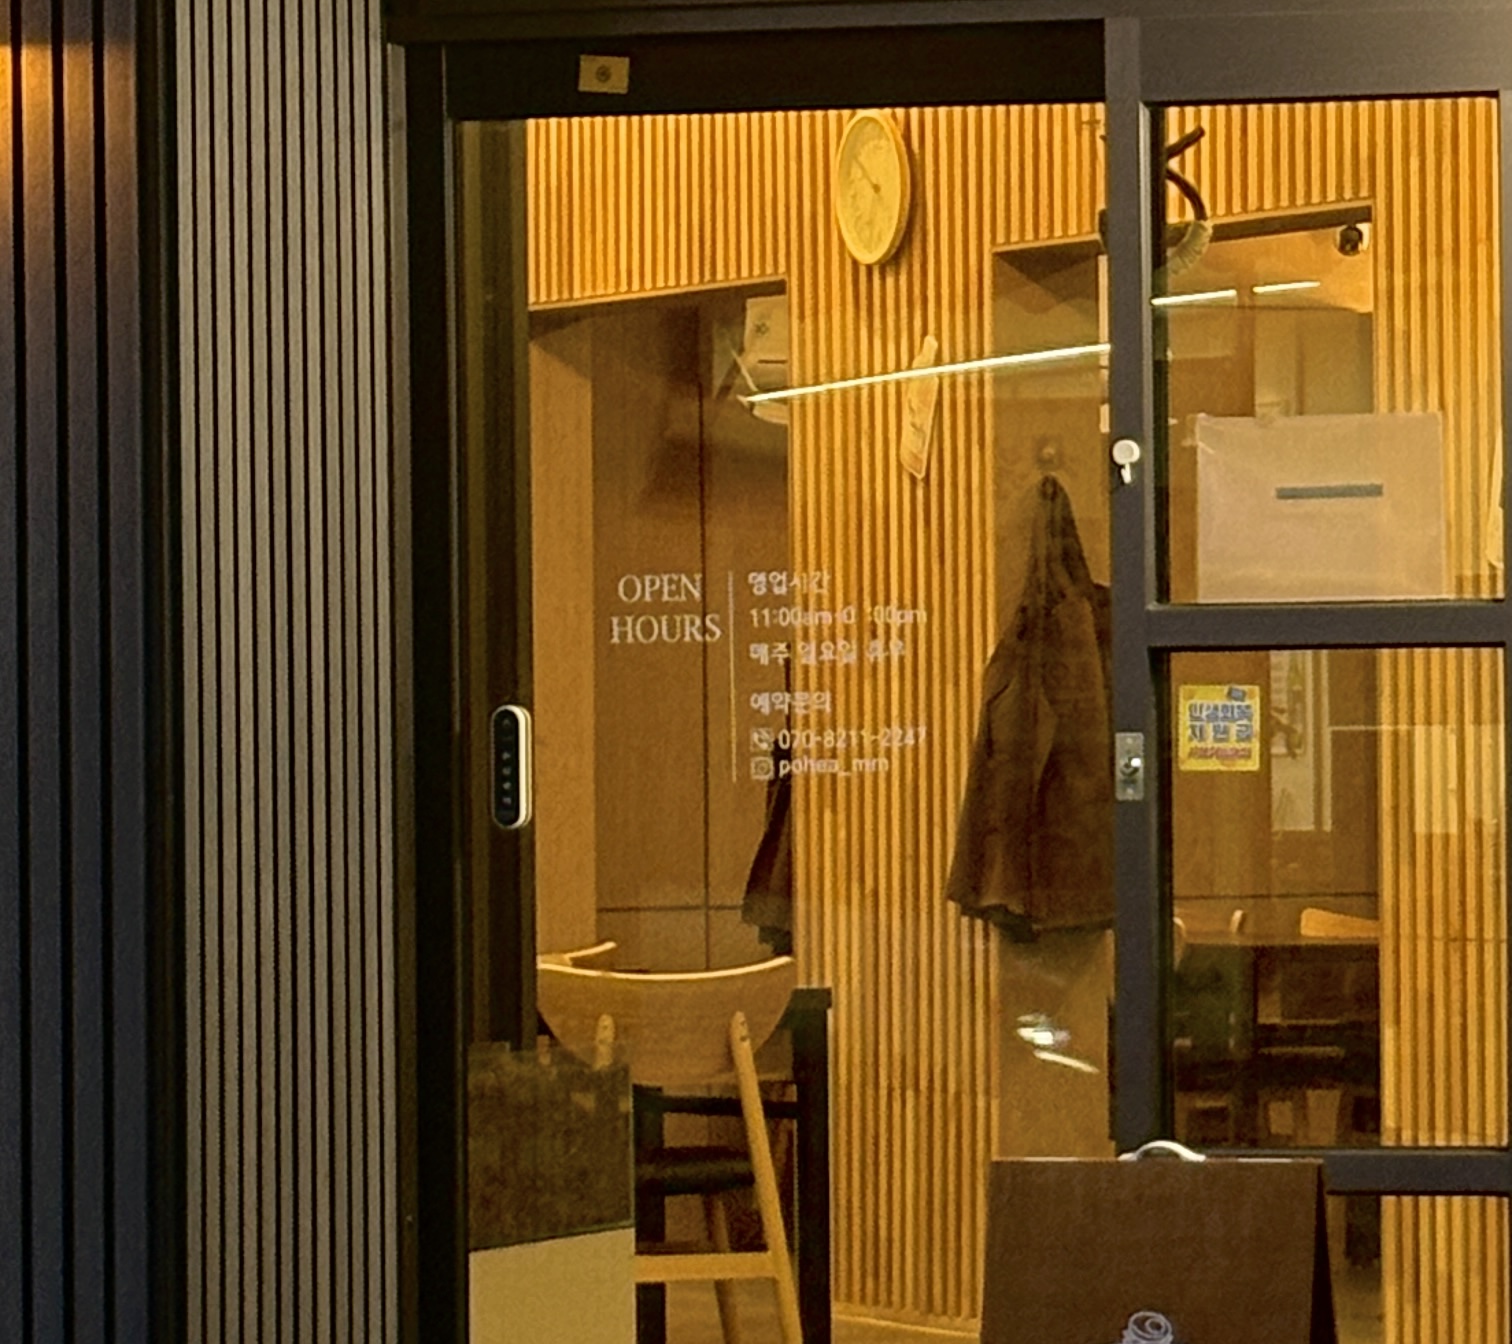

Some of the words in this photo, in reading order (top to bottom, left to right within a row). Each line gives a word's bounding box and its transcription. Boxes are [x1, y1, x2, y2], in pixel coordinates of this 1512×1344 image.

[617, 573, 703, 604] OPEN
[748, 570, 831, 596] 영업시간
[609, 613, 723, 644] HOURS
[749, 641, 792, 665] 매주
[798, 639, 857, 664] 일요일
[750, 692, 832, 717] 예약문의
